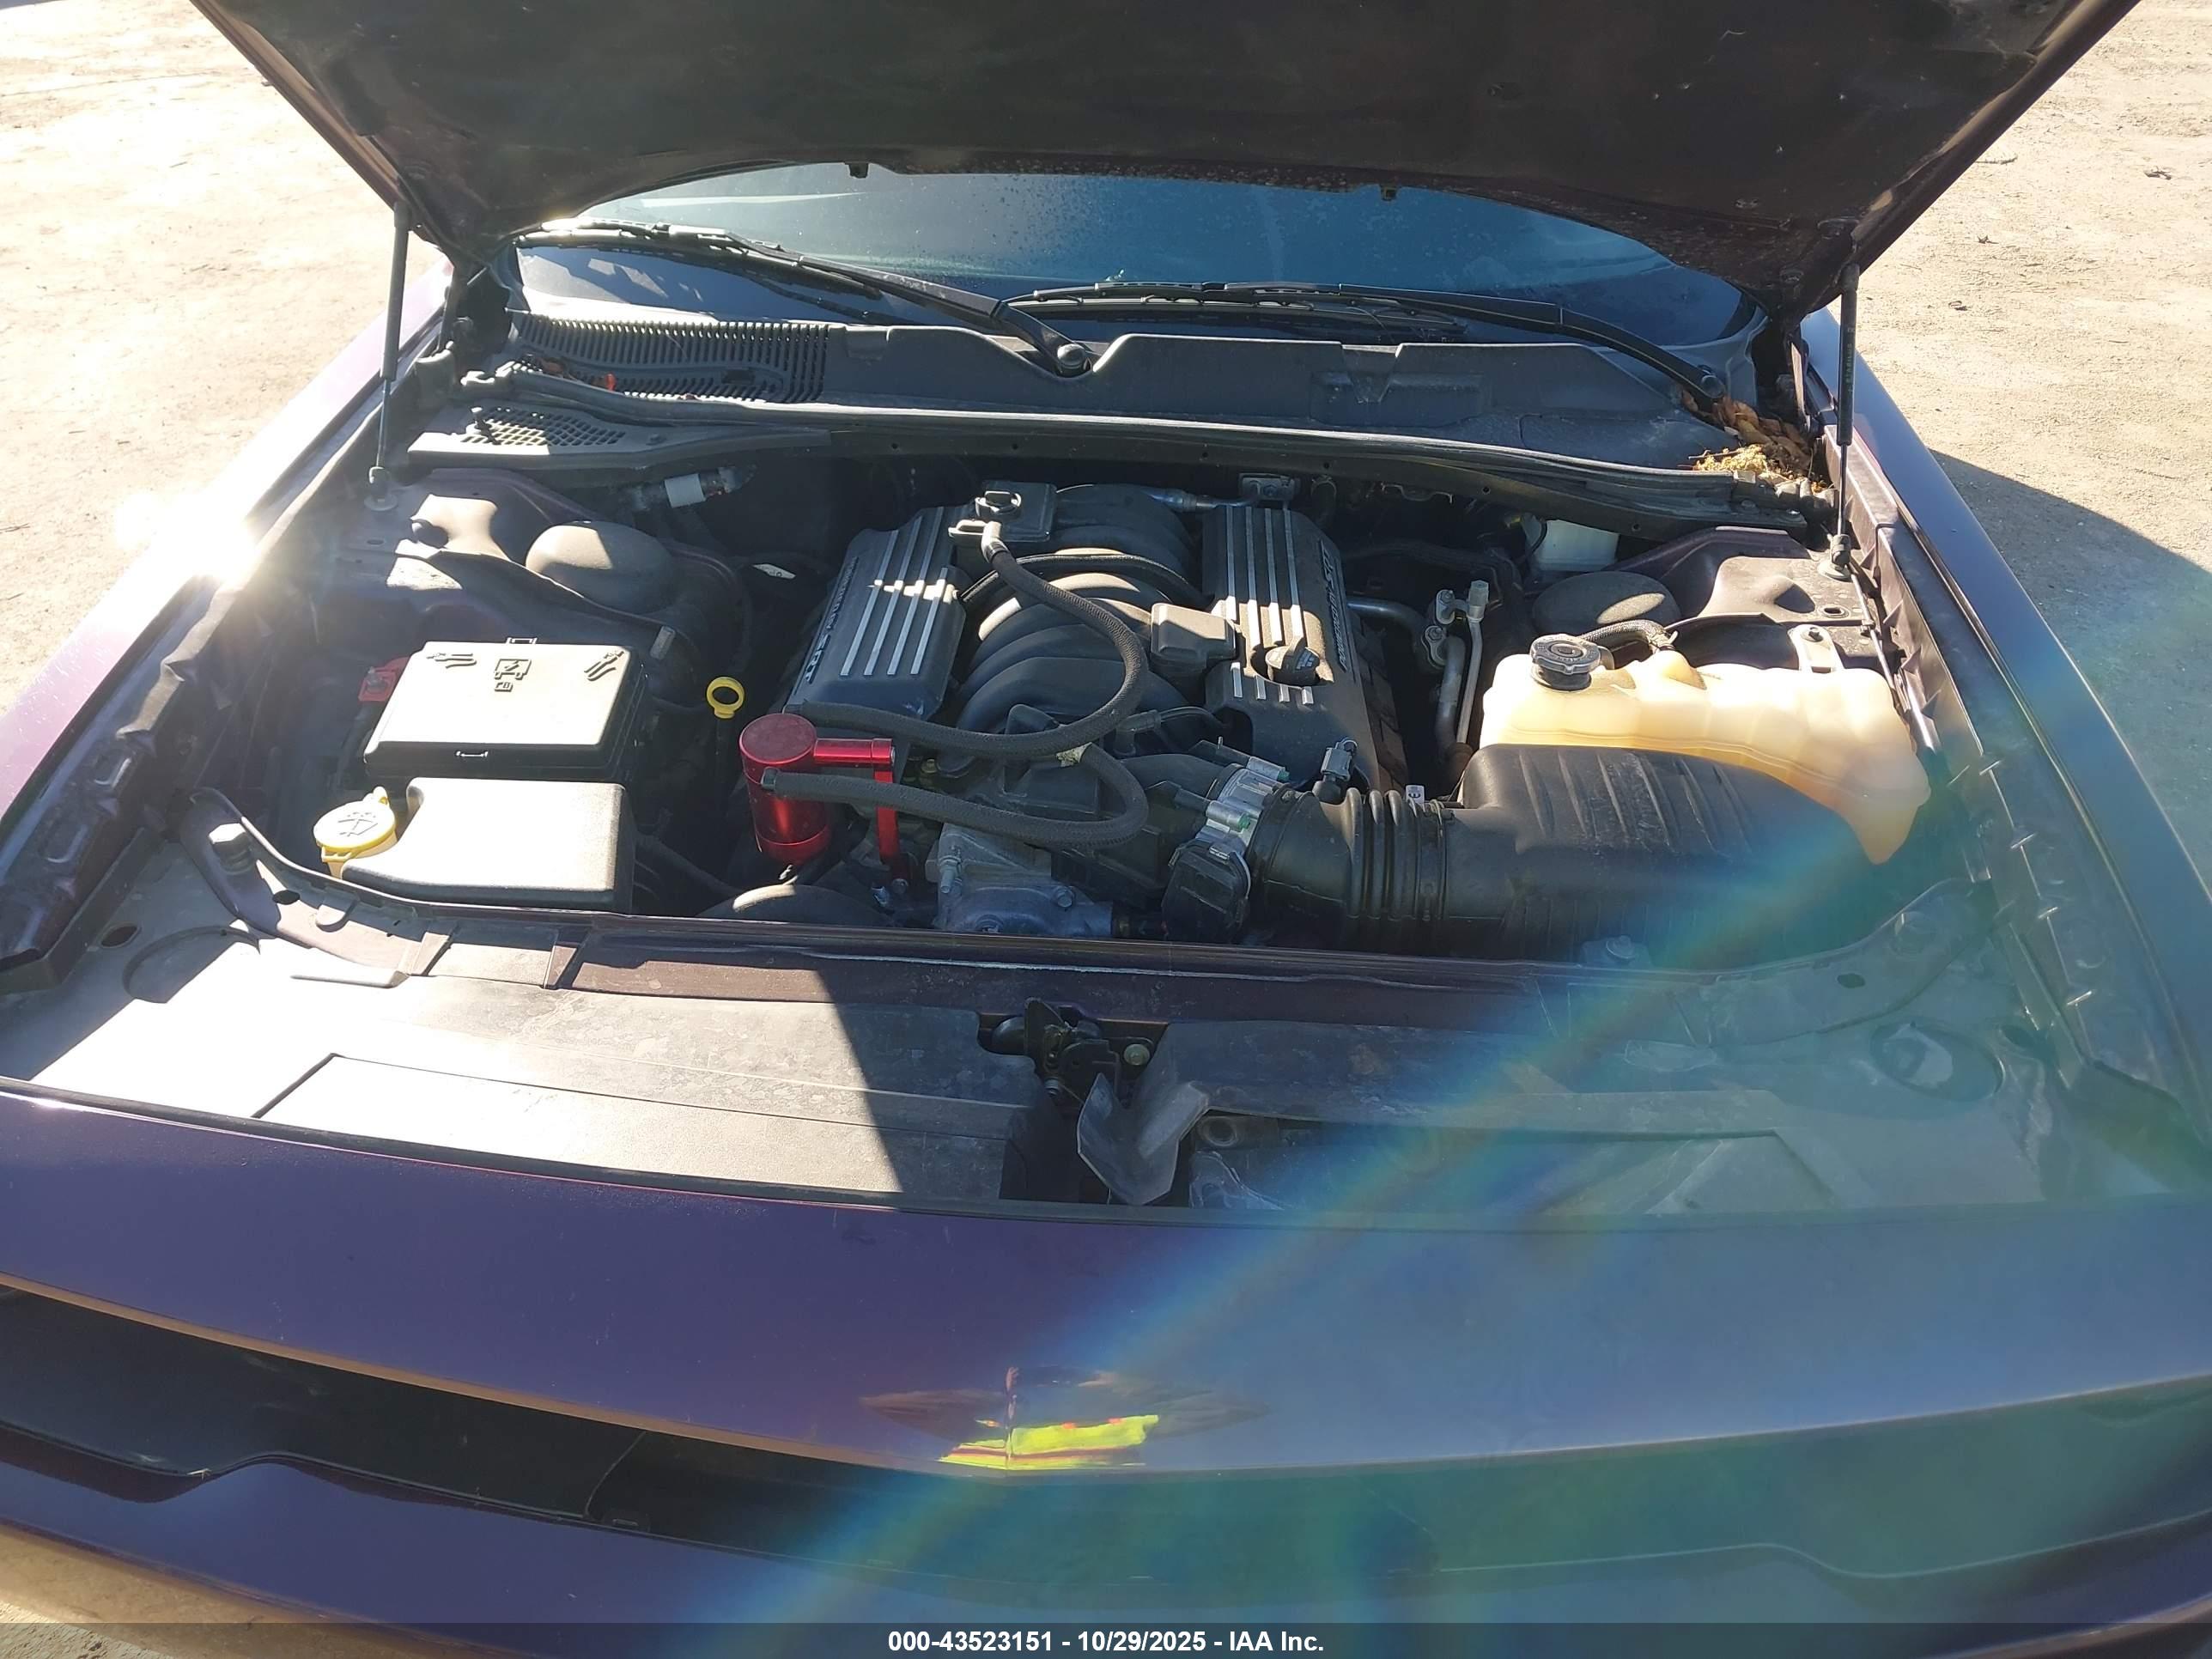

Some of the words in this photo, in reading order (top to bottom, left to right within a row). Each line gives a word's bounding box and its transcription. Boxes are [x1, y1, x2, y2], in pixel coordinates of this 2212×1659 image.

[1321, 539, 1334, 588] SRT
[805, 634, 830, 684] SRT
[1332, 605, 1346, 672] POWERED
